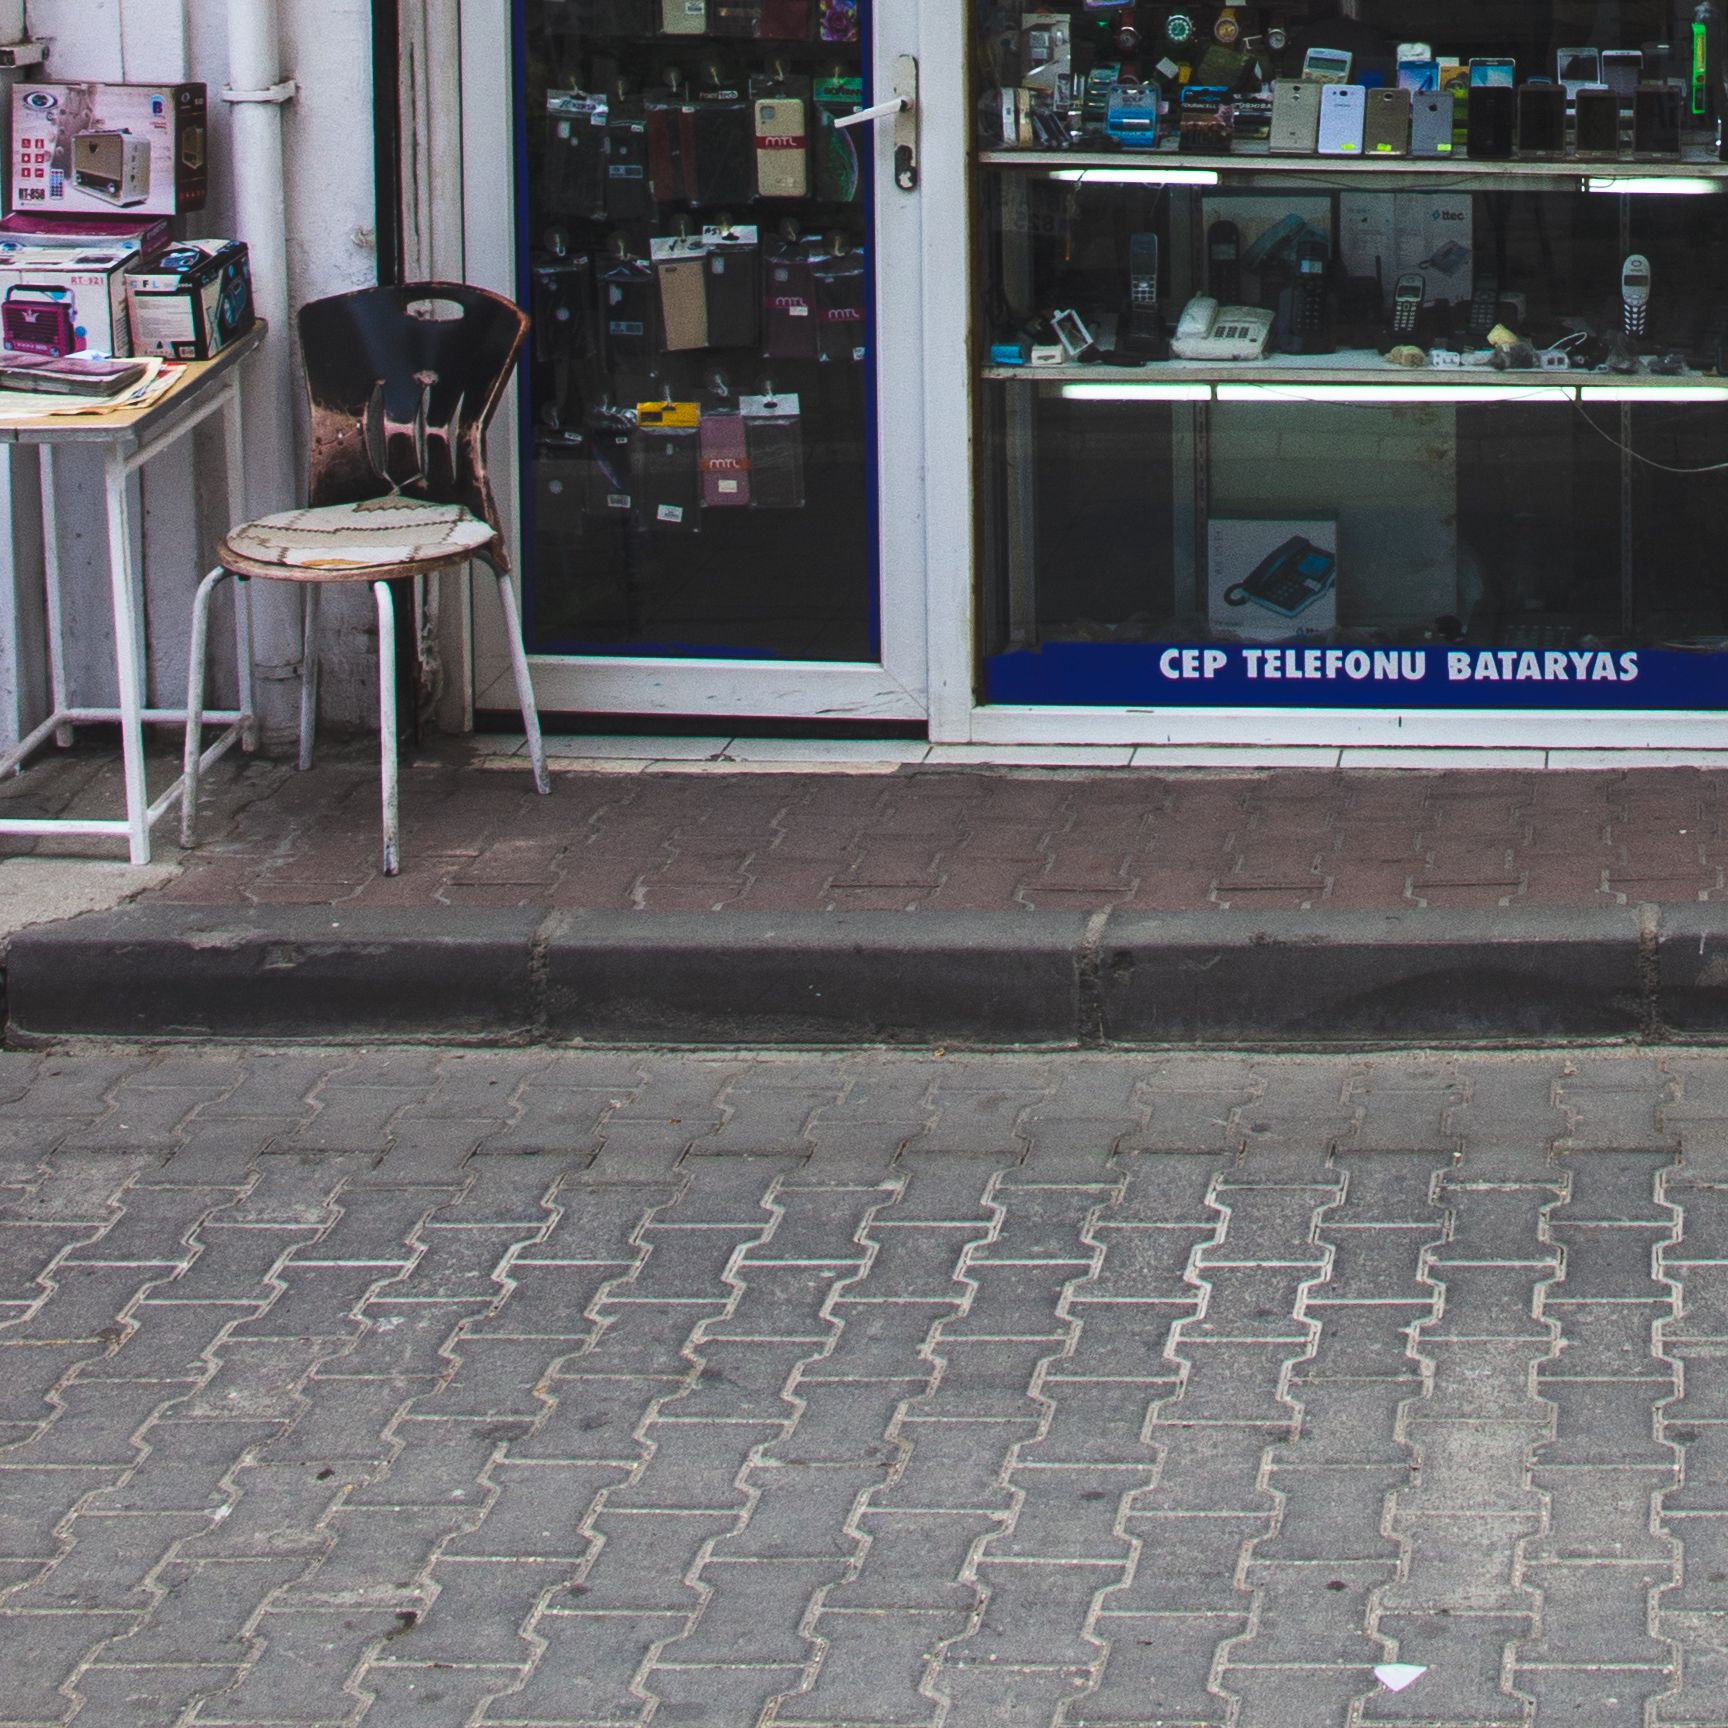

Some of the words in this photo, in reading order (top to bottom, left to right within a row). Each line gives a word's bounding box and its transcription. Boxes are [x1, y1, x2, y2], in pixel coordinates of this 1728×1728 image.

[1159, 648, 1227, 679] CEP
[1242, 648, 1426, 680] TELEFONU
[1447, 650, 1639, 682] BATARYAS
